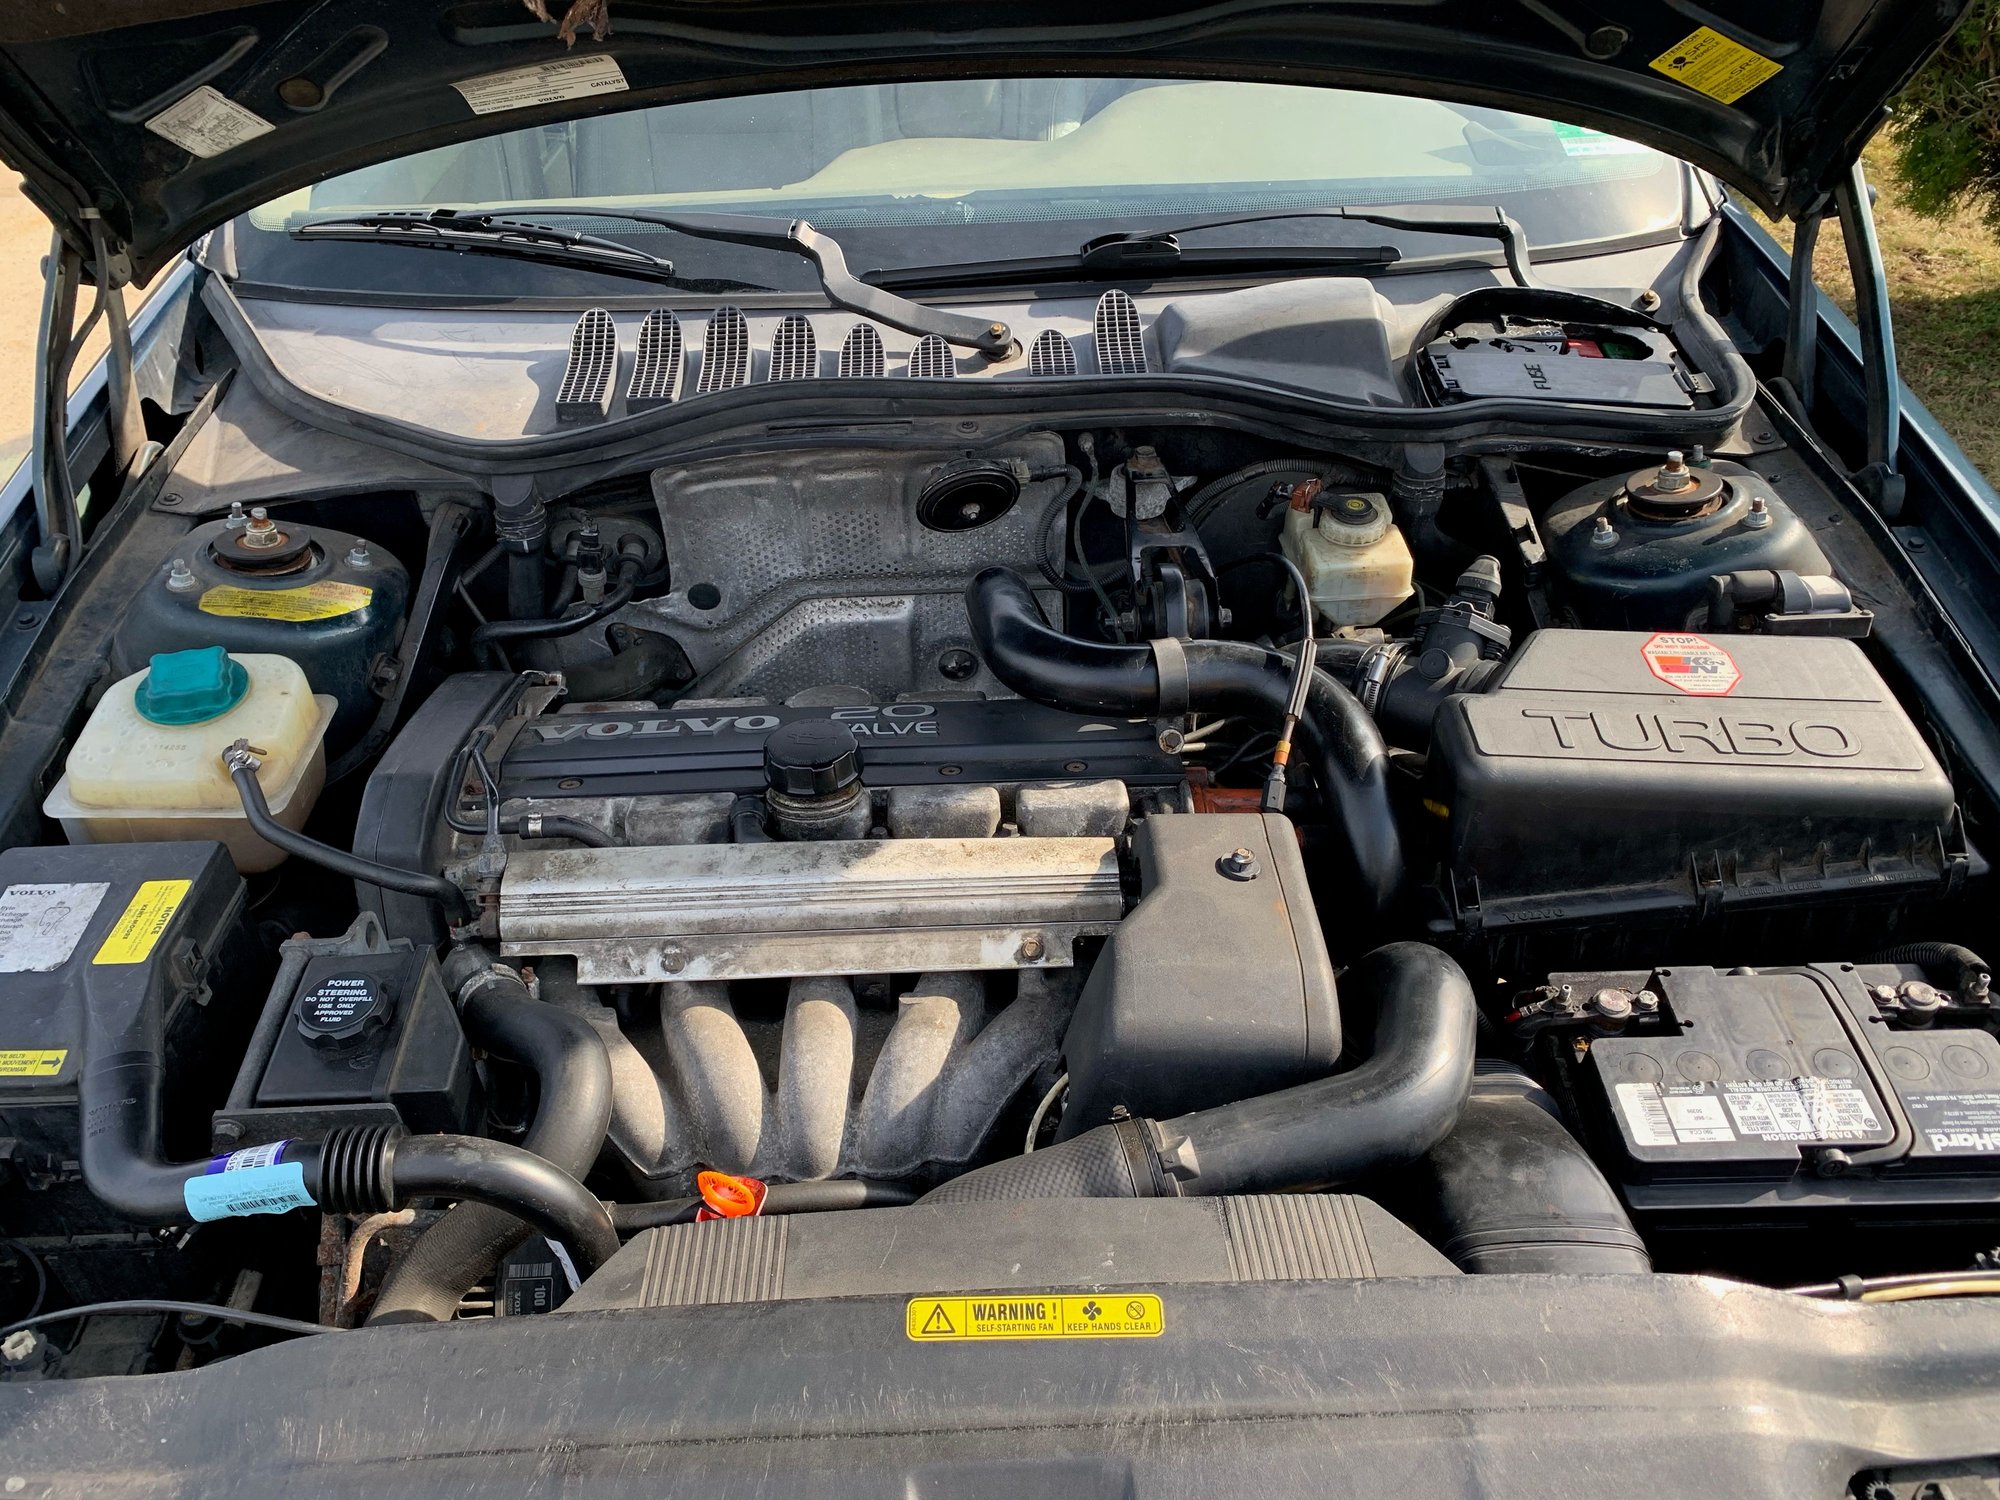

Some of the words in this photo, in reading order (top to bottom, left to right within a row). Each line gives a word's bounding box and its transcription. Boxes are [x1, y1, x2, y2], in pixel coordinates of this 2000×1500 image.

[1657, 33, 1699, 64] ATTENTION
[1685, 36, 1715, 56] SRS
[1693, 41, 1721, 61] VEHICLE
[1731, 56, 1761, 76] SRS
[590, 78, 626, 88] CATALYST
[537, 94, 566, 103] VOLVO
[1524, 363, 1552, 390] FUSE
[1660, 636, 1698, 645] STOP!
[830, 704, 937, 720] 20
[529, 714, 781, 741] VOLVO
[848, 721, 939, 736] ALVE
[1522, 707, 1863, 757] TURBO
[151, 906, 174, 935] NOTICE
[1502, 908, 1564, 922] VOLVO
[534, 1285, 547, 1306] 100
[973, 1303, 1046, 1321] WARNING
[976, 1323, 1036, 1333] SELF-STARTING
[1038, 1322, 1054, 1332] FAN
[1067, 1323, 1090, 1332] KEEP
[1092, 1322, 1122, 1331] HANDS
[1124, 1322, 1151, 1331] CLEAR
